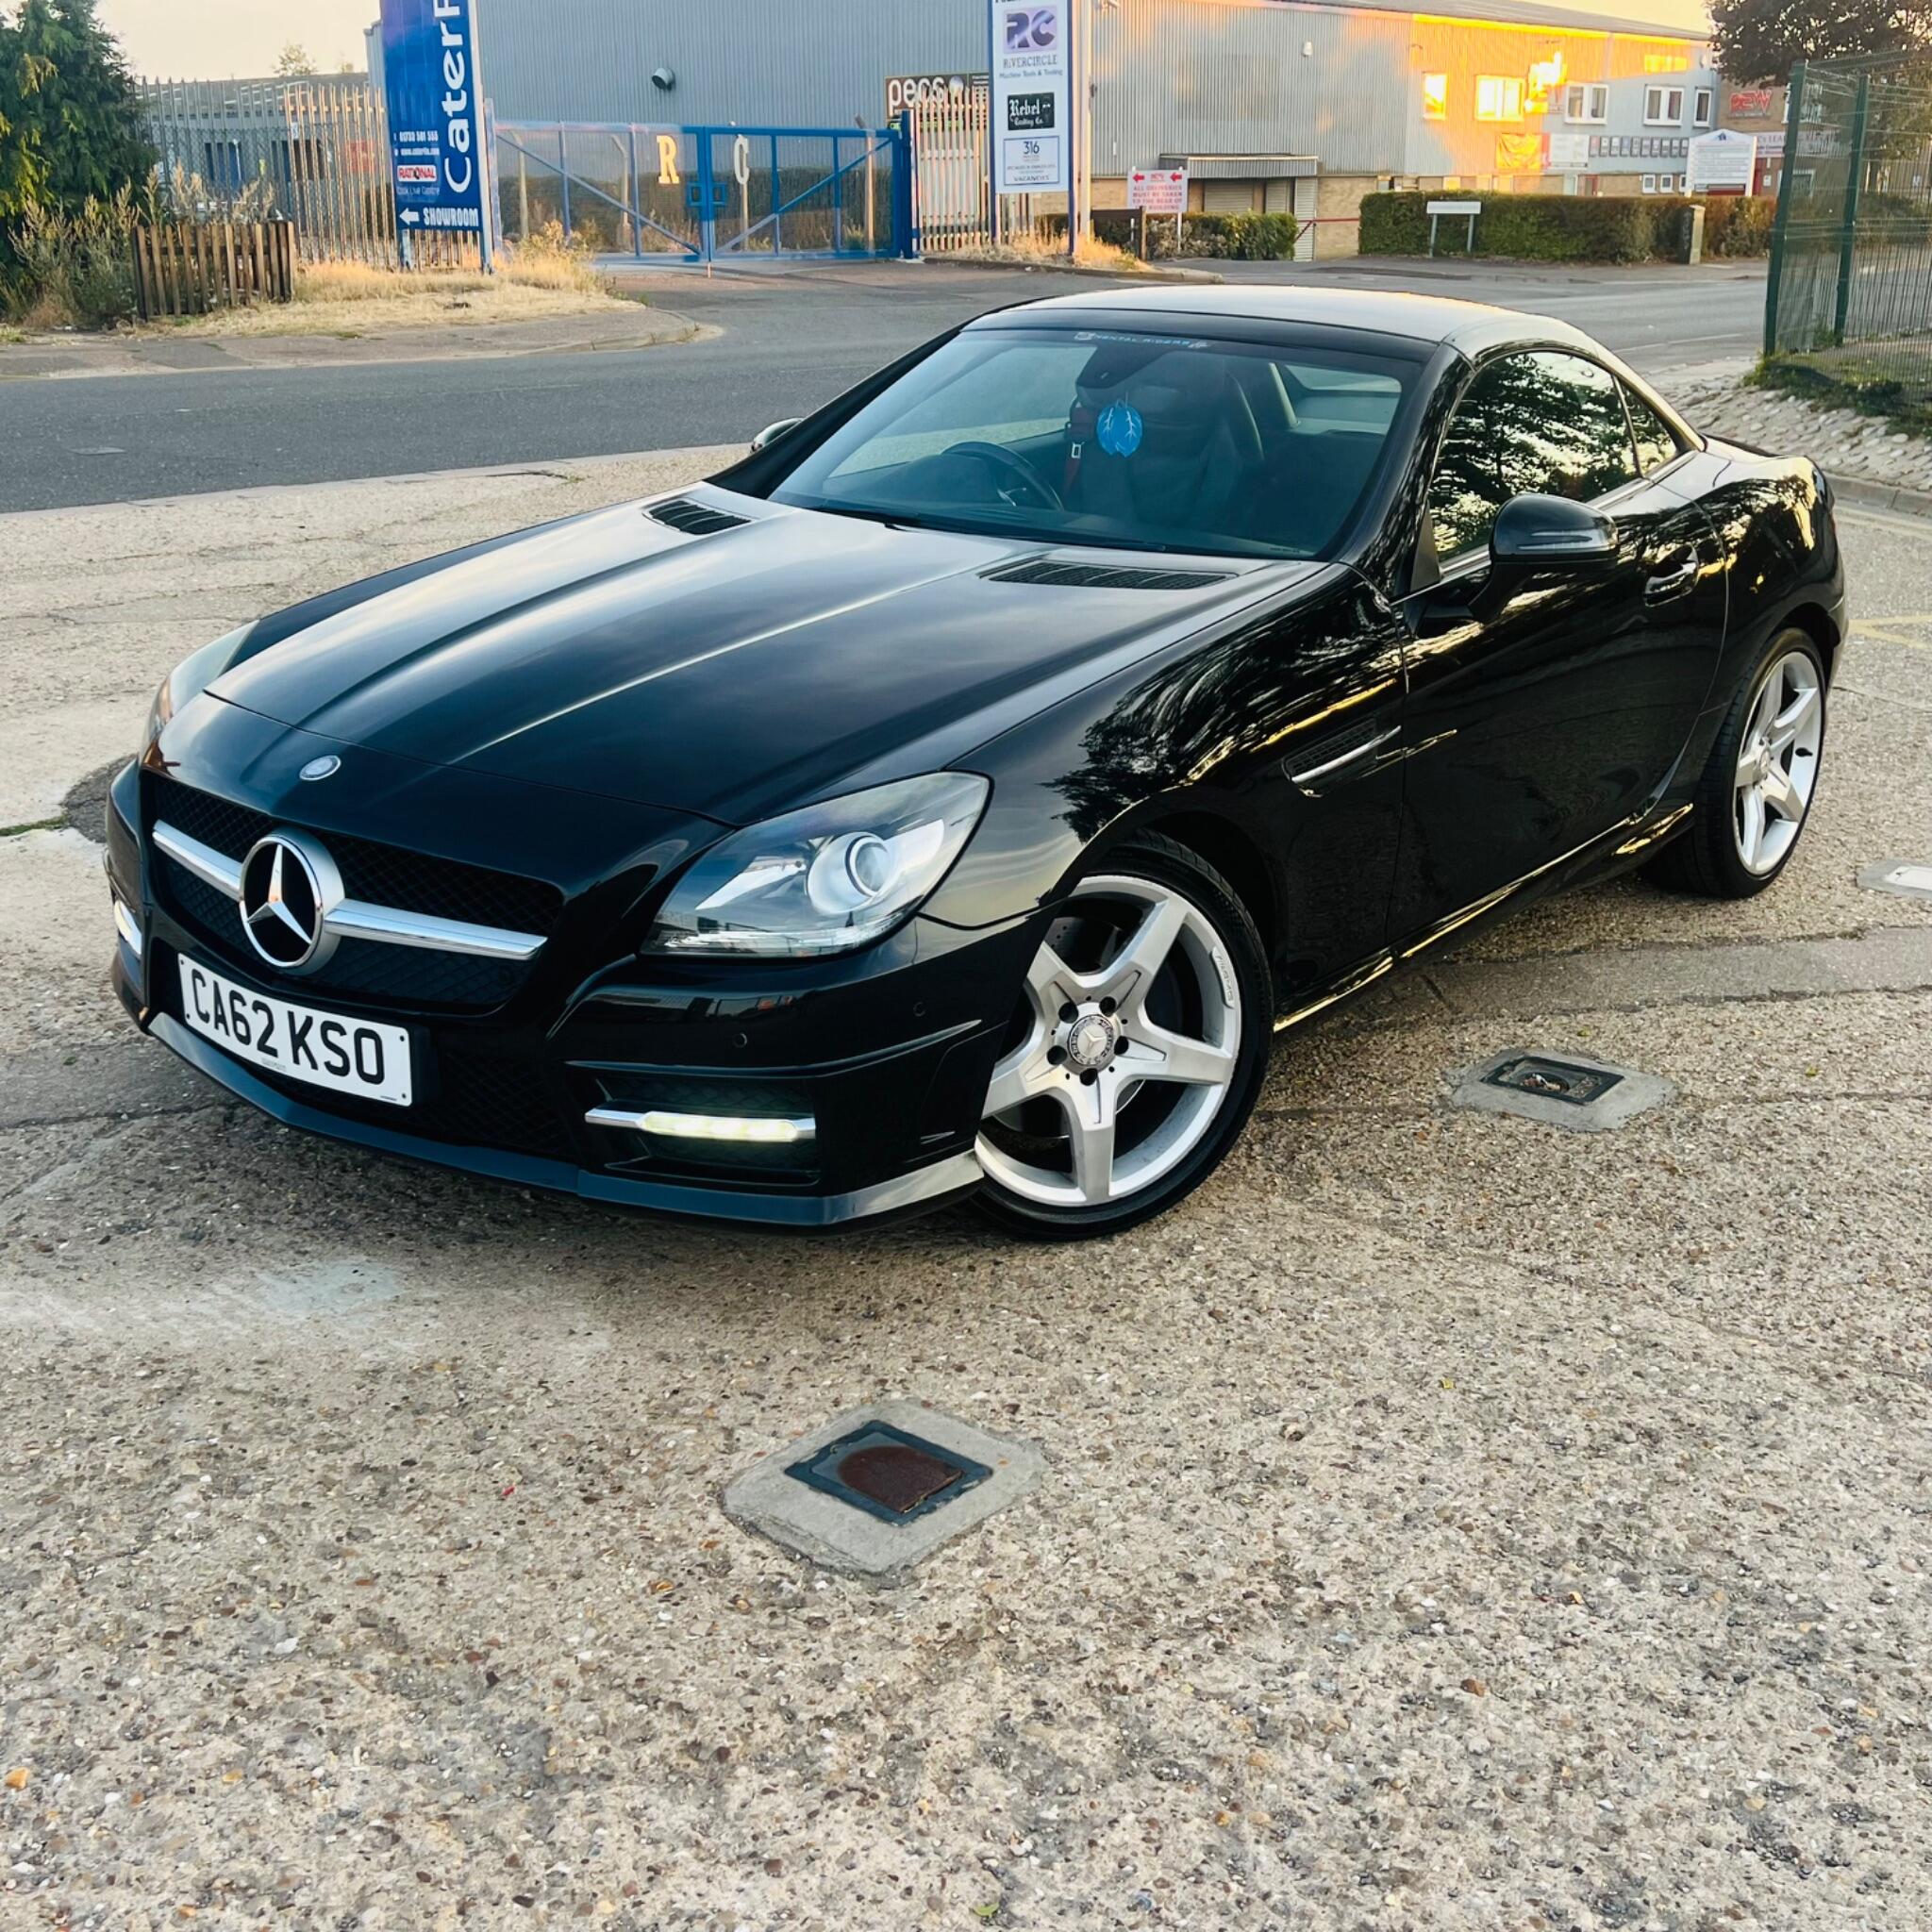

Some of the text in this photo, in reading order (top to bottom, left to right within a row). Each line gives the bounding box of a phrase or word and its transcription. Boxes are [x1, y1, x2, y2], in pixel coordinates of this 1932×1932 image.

[1007, 9, 1056, 48] RC
[1009, 98, 1041, 116] Rebel
[1023, 141, 1041, 155] 316
[399, 166, 436, 179] RATIONAL
[423, 207, 479, 227] SHOWROOM
[192, 968, 385, 1085] CA62 KSO
